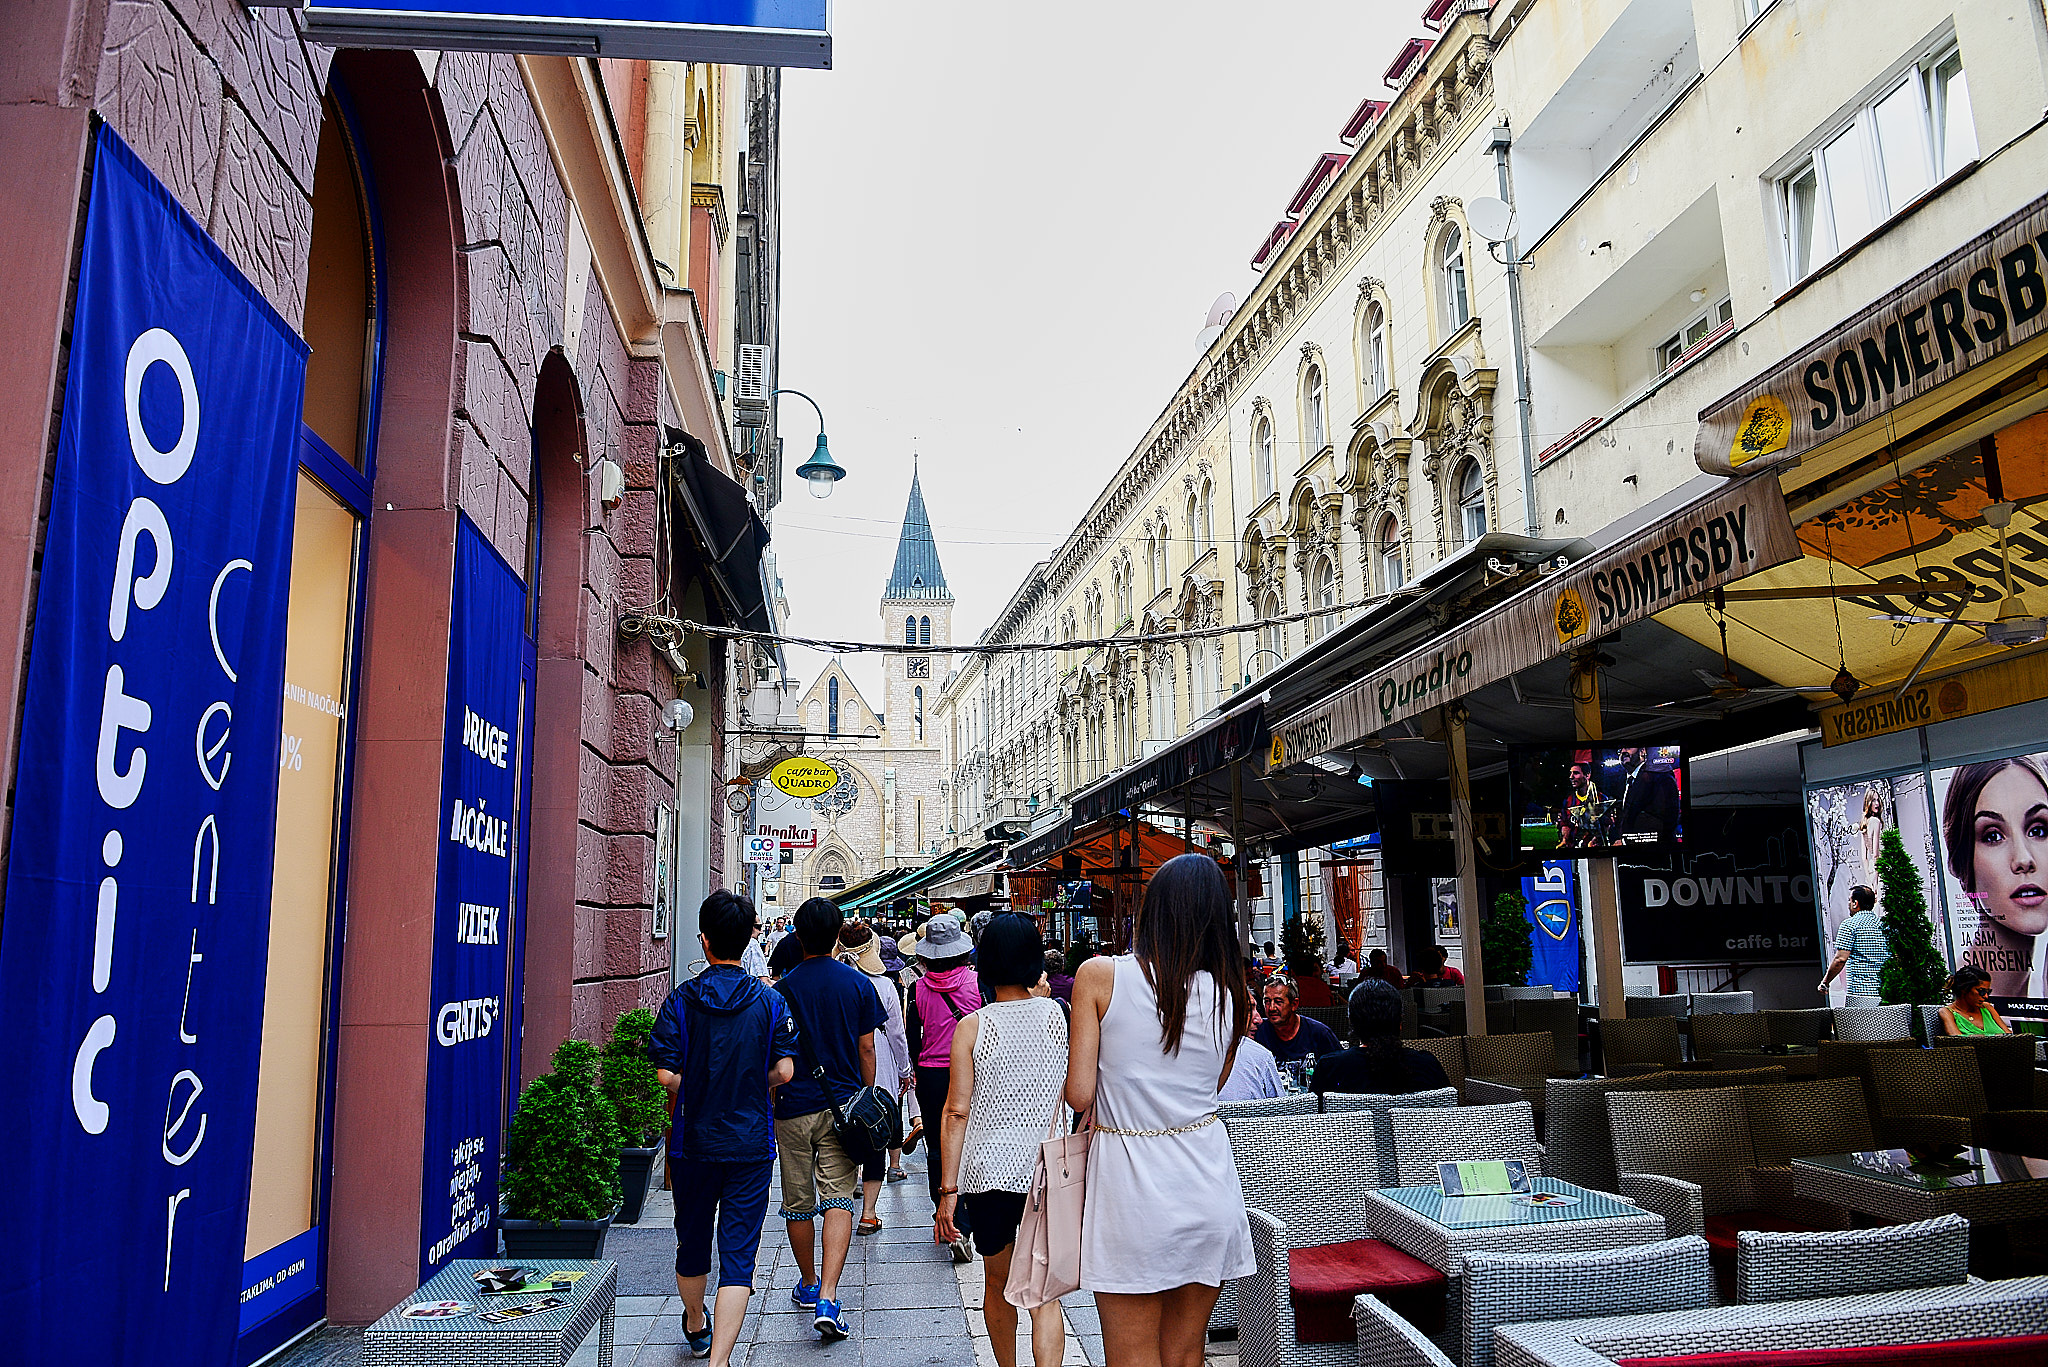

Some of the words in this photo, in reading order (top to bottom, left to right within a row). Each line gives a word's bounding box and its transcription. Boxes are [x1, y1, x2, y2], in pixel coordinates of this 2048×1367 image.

[1379, 650, 1472, 722] Quadro
[308, 690, 345, 720] NAOČALA
[778, 775, 831, 789] QUADRO
[786, 768, 812, 777] caffe
[814, 768, 831, 776] bar
[1725, 934, 1773, 950] caffe
[1778, 934, 1809, 948] bar
[1961, 931, 1973, 947] JA
[1975, 931, 1997, 947] SAM
[1962, 945, 2035, 972] SAVRŠENA
[276, 1269, 287, 1284] OD
[287, 1258, 305, 1278] 49KM
